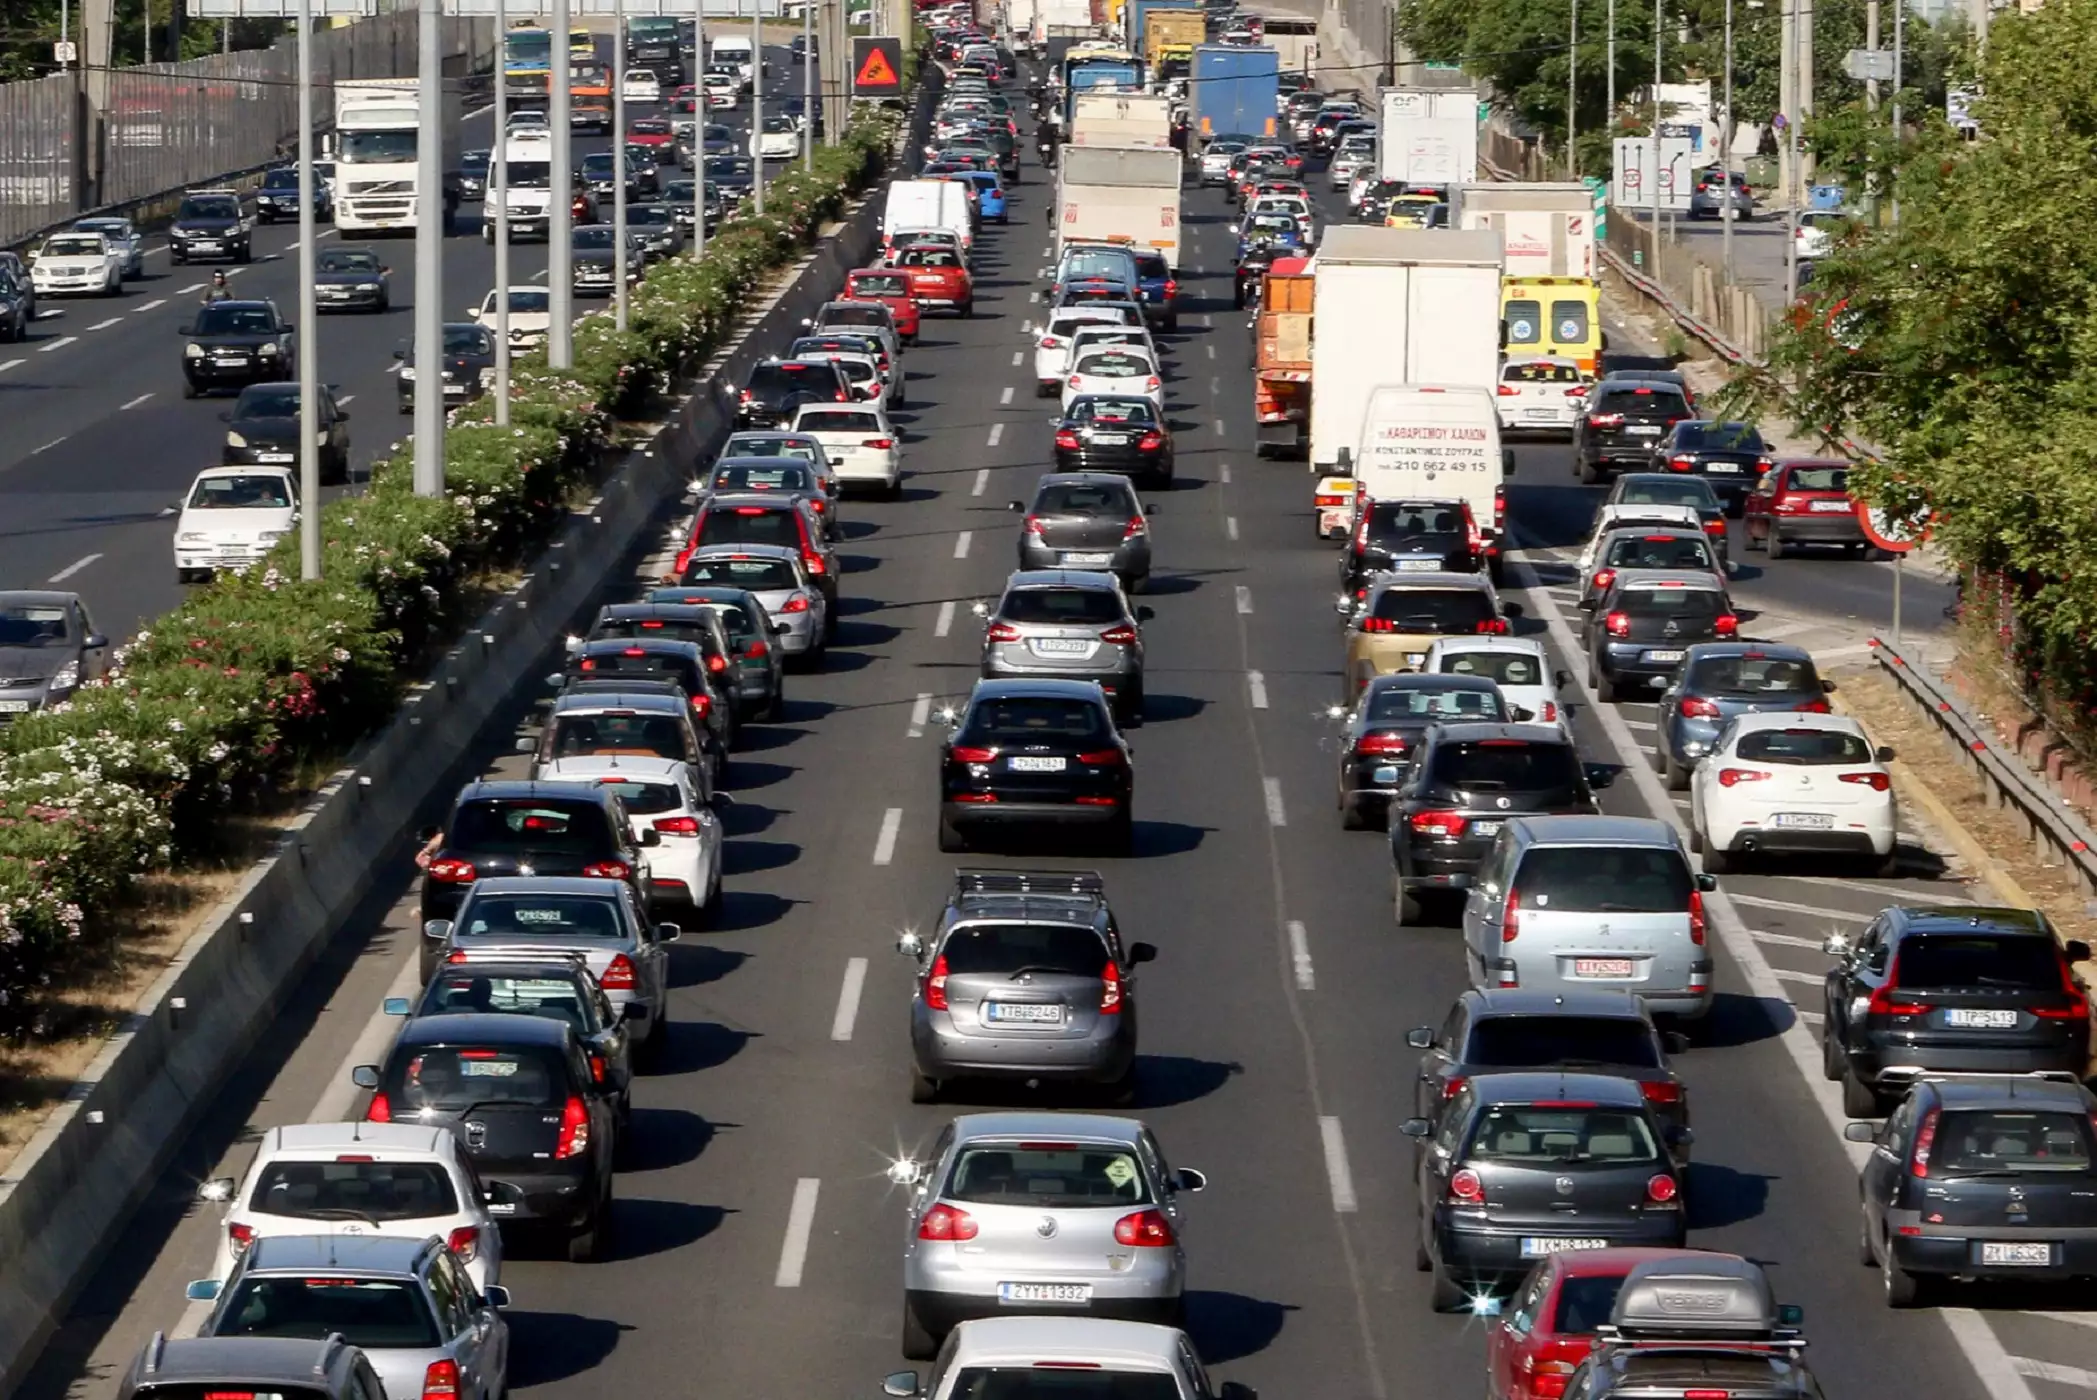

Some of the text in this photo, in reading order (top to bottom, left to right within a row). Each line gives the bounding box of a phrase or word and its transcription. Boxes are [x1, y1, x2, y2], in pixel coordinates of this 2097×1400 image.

[1423, 461, 1447, 472] 662
[1450, 462, 1468, 473] 49
[1470, 462, 1487, 473] 15
